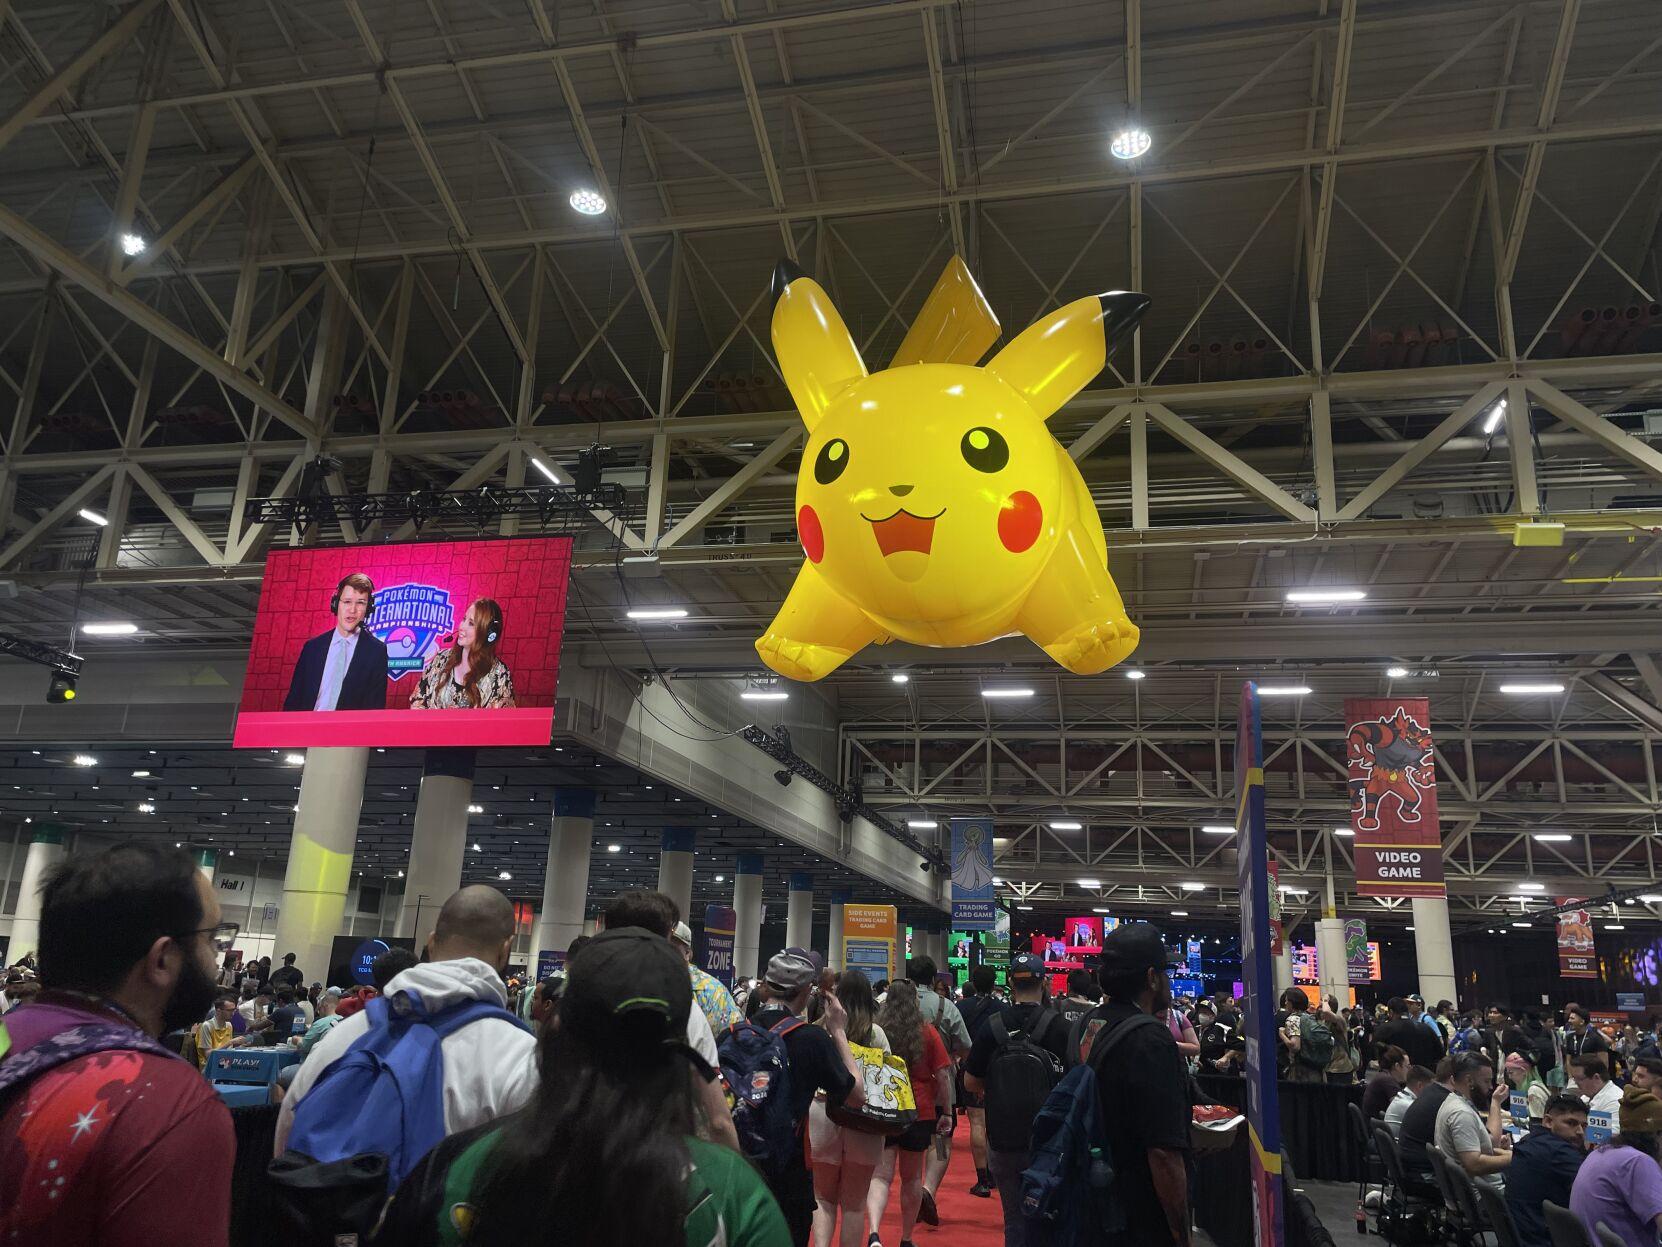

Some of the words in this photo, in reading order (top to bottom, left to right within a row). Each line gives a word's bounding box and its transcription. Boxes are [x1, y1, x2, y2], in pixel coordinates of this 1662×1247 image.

[383, 588, 433, 603] POKÉMON
[364, 602, 451, 627] NTERNATIONAL
[369, 620, 443, 632] HAMPIONSHIPS
[1375, 851, 1421, 863] VIDEO
[1378, 866, 1422, 878] GAME
[220, 879, 239, 891] Hall
[707, 950, 731, 971] ZONE
[1589, 1118, 1607, 1127] 918
